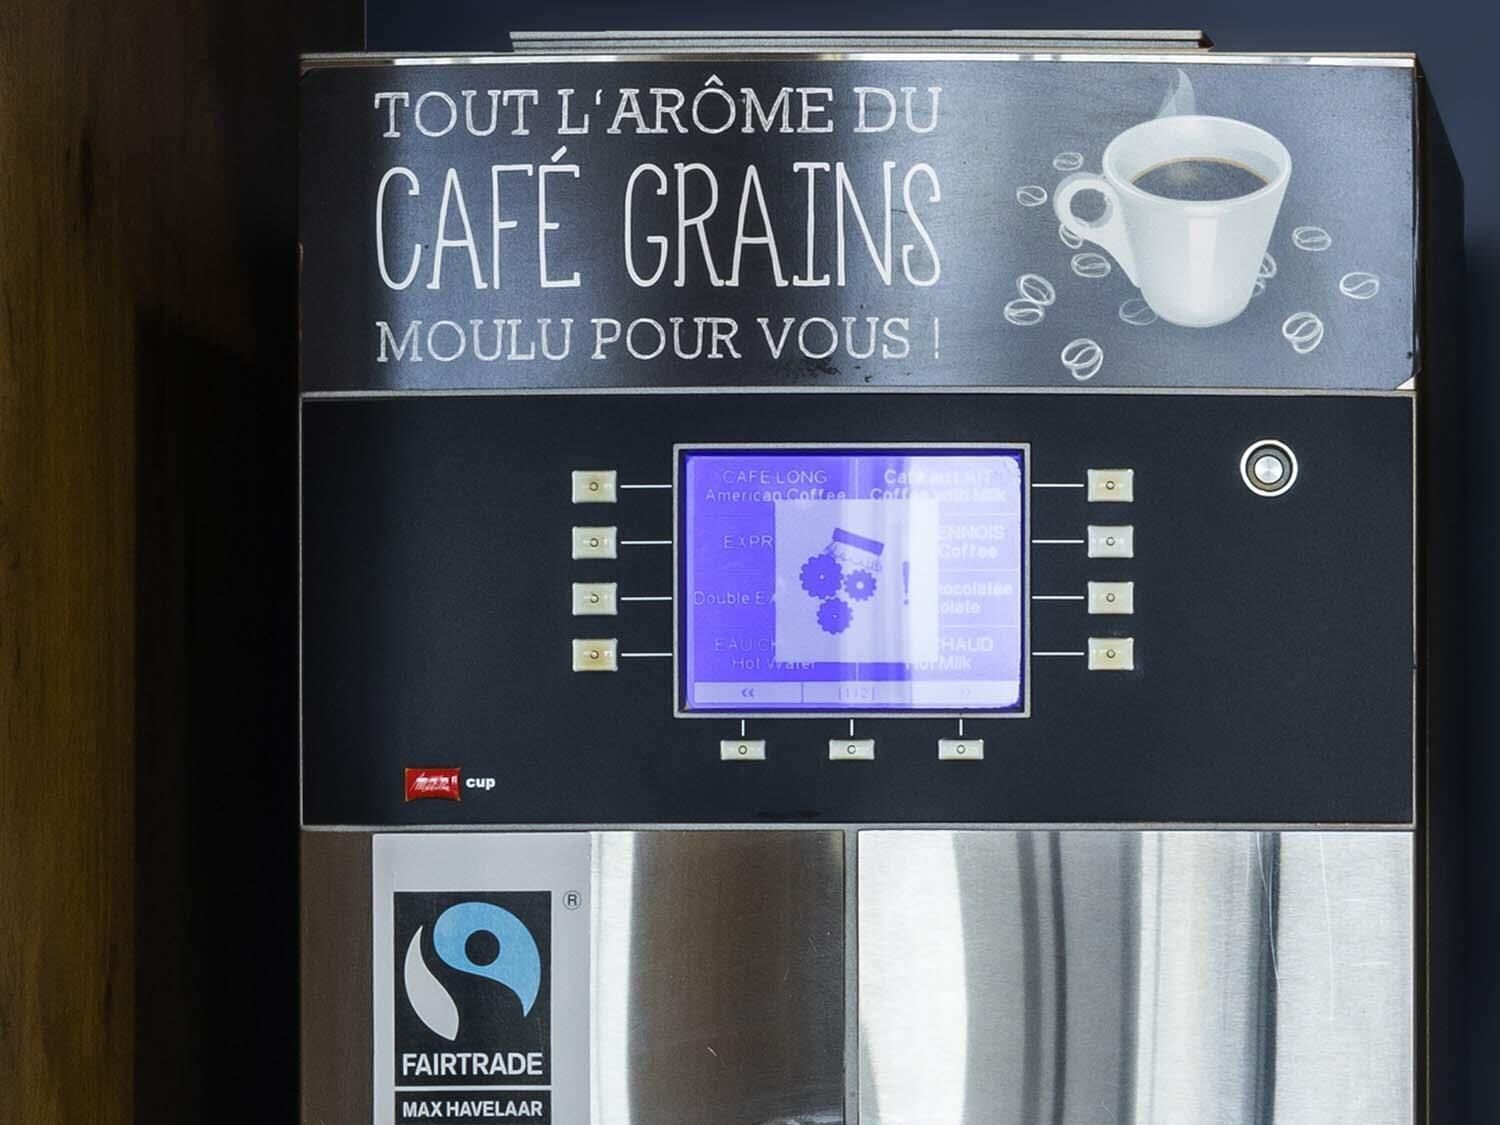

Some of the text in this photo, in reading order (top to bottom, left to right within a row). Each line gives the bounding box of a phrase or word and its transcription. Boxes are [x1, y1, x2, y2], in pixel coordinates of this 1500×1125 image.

[374, 89, 538, 139] TOUT
[853, 86, 943, 133] DU
[375, 145, 942, 291] CAFÉ GRAINS
[375, 316, 941, 363] MOULU POUR VOUS !
[776, 469, 828, 484] LONG
[705, 488, 846, 501] American Coffee
[693, 590, 750, 605] Double
[731, 657, 760, 671] Hot
[465, 777, 496, 791] cup
[402, 1052, 543, 1076] FAIRTRADE
[402, 1101, 543, 1118] MAX HAVELAAR
